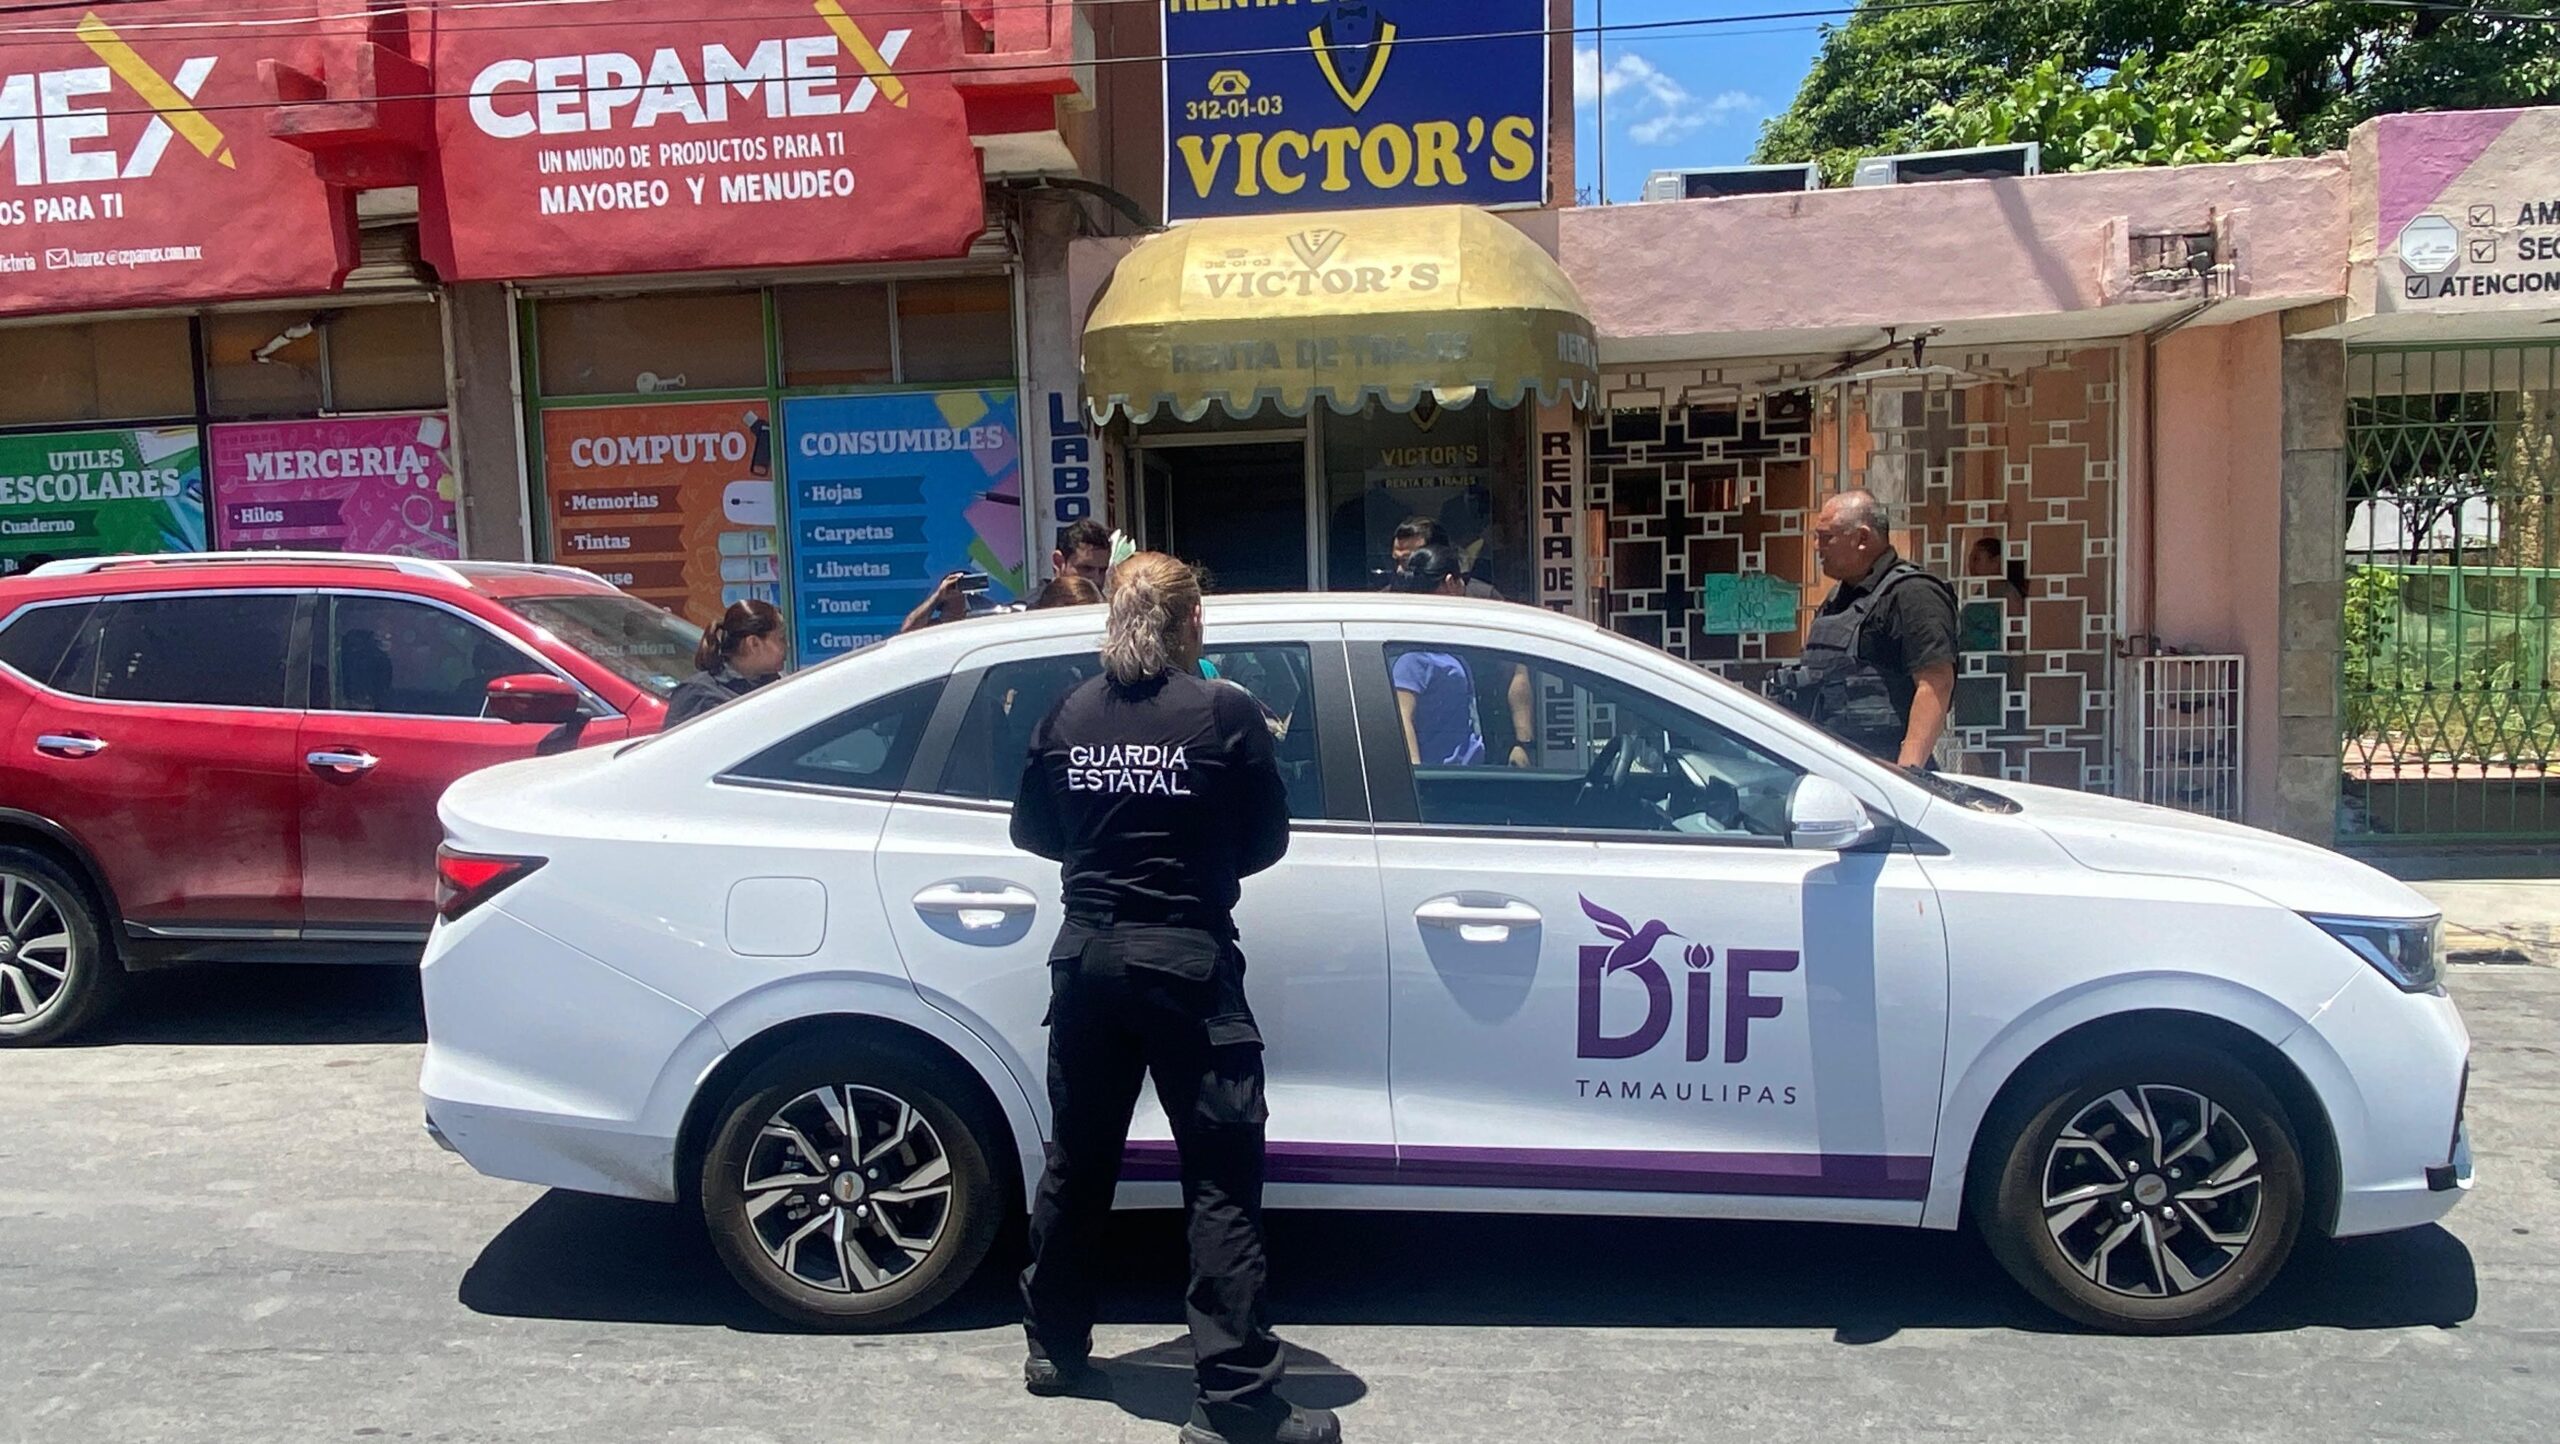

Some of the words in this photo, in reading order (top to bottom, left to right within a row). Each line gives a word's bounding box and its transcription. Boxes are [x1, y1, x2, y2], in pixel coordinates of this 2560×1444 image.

[468, 29, 912, 139] CEPAMEX
[1185, 95, 1283, 120] 312-01-03
[538, 149, 562, 174] UN
[565, 145, 626, 172] MUNDO
[629, 144, 651, 169] DE
[659, 136, 768, 168] PRODUCTOS
[773, 133, 824, 159] PARA
[828, 131, 845, 156] TI
[1176, 116, 1535, 198] VICTOR'S
[540, 179, 669, 215] MAYOREO
[685, 176, 706, 206] Y
[720, 168, 855, 204] MENUDEO
[34, 195, 95, 223] PARA
[100, 193, 124, 218] TI
[1205, 263, 1440, 298] VICTOR'S
[2439, 272, 2560, 297] ATENCION
[1172, 341, 1281, 374] RENTA
[1296, 338, 1340, 369] DE
[571, 431, 747, 467] COMPUTO
[800, 424, 1004, 457] CONSUMIBLES
[48, 449, 125, 472] UTILES
[245, 445, 424, 481] MERCERIA
[1381, 444, 1478, 466] VICTOR'S
[1048, 392, 1092, 549] LABO
[1385, 478, 1420, 488] RENTA
[0, 468, 181, 504] ESCOLARES
[811, 483, 863, 504] Hojas
[1542, 431, 1573, 560] RENTA
[571, 491, 659, 510] Memorias
[1, 518, 76, 534] Cuaderno
[241, 507, 284, 524] Hilos
[574, 533, 631, 550] Tintas
[814, 525, 894, 544] Carpetas
[816, 561, 890, 577] Libretas
[1543, 567, 1573, 591] DE
[818, 598, 871, 613] Toner
[1069, 744, 1189, 770] GUARDIA
[1067, 768, 1191, 795] ESTATAL
[1575, 1079, 1798, 1105] TAMAULIPAS
